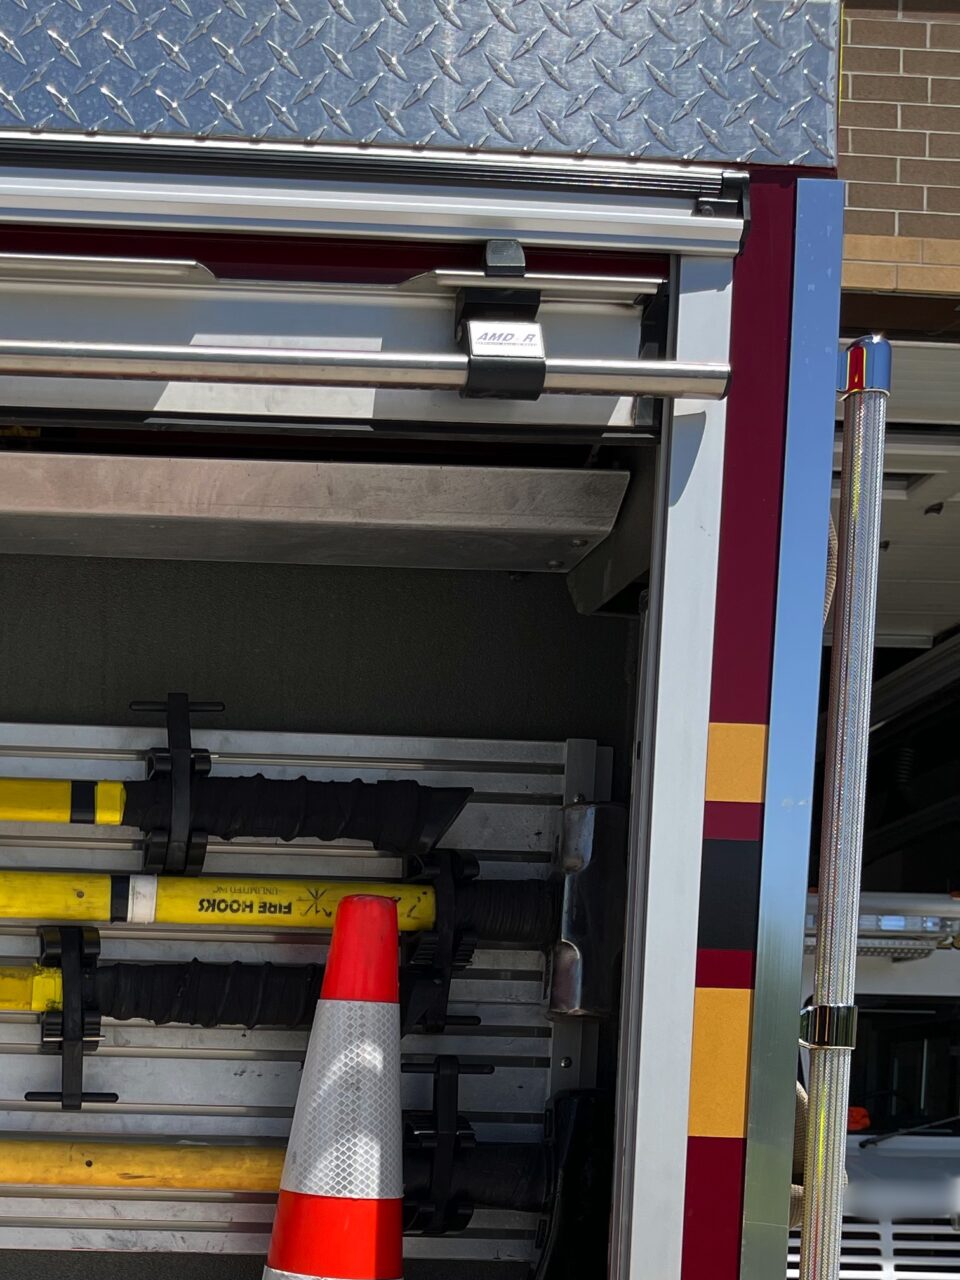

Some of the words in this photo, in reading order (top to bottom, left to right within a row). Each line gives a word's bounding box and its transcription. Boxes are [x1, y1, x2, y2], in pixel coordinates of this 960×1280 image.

[477, 332, 536, 342] AMDR
[198, 897, 254, 914] HOOKS
[258, 900, 293, 915] FIRE
